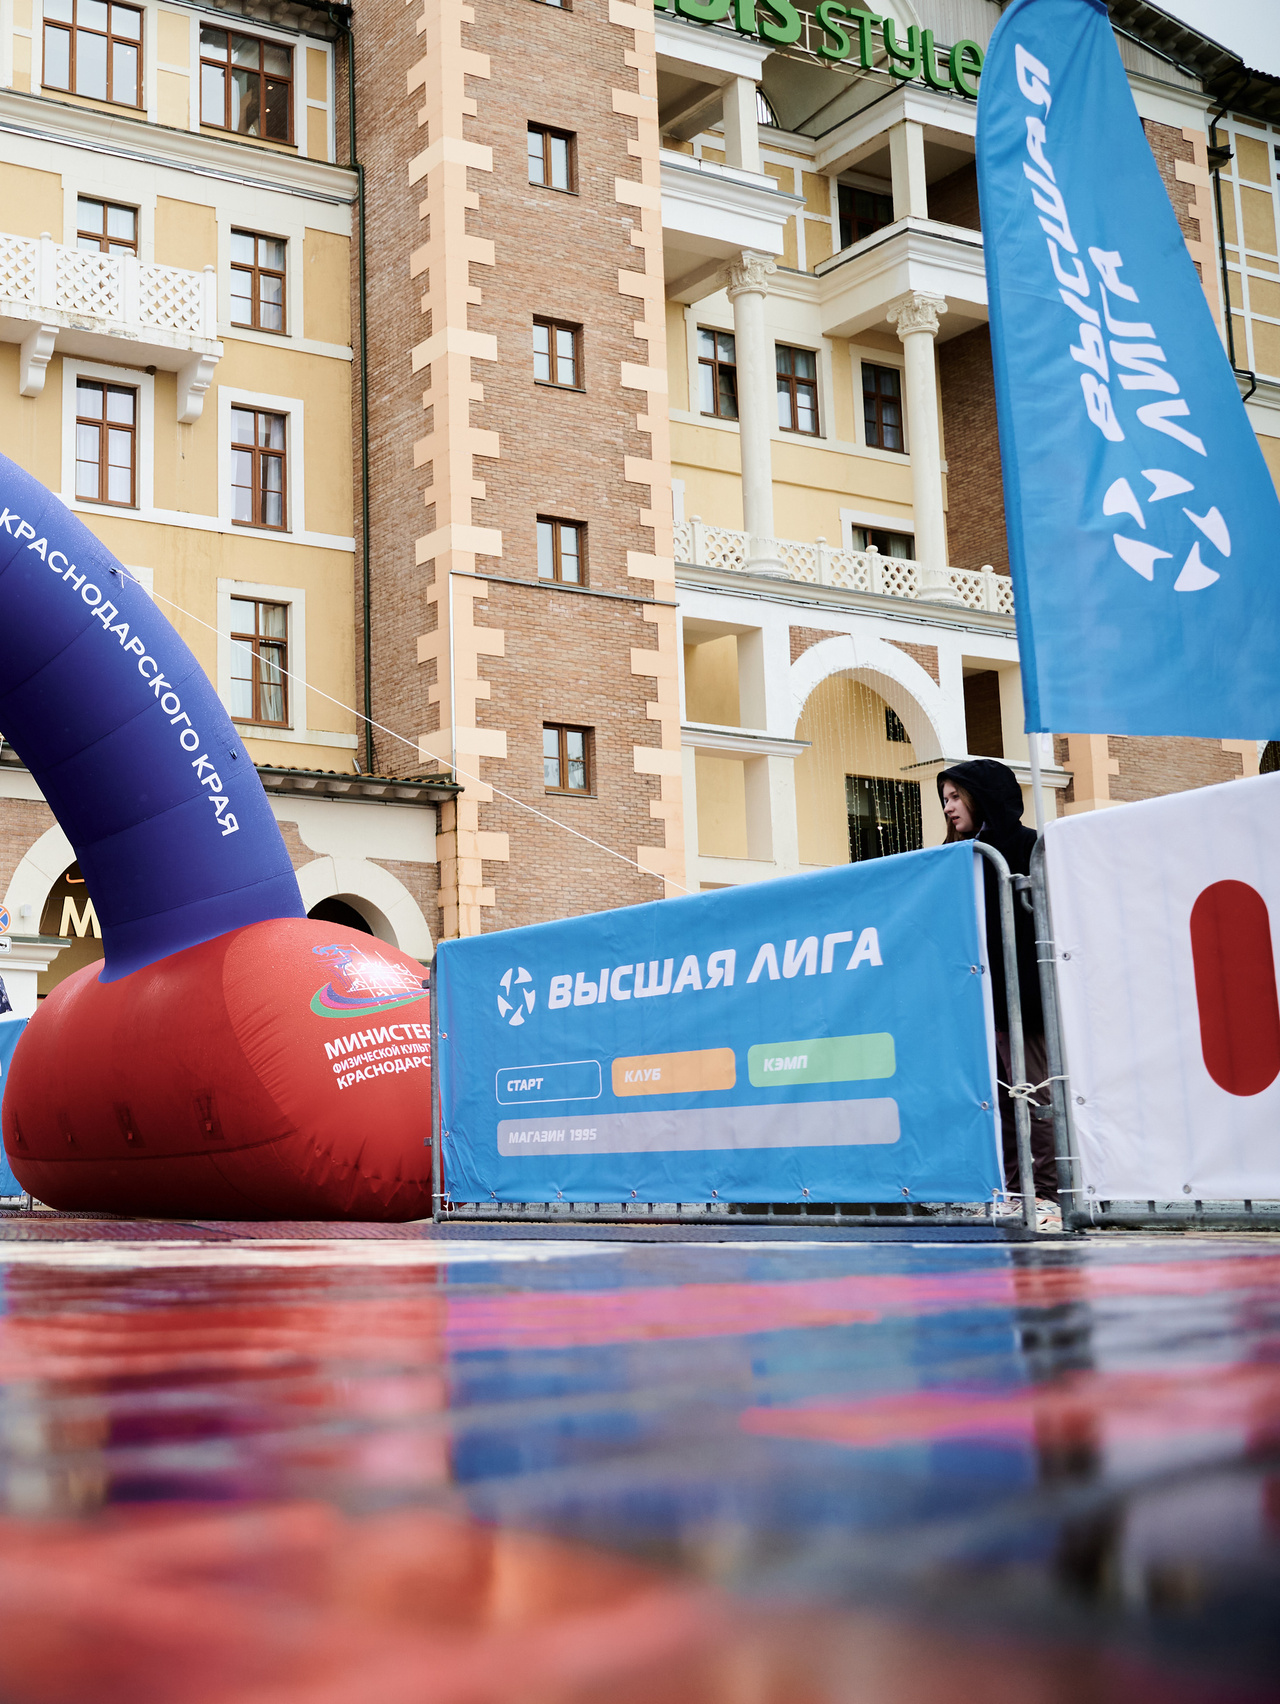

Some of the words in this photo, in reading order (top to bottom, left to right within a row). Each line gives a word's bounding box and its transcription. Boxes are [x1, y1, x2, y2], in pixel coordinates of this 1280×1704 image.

[1015, 43, 1125, 441] ВЫСШАЯ
[1088, 247, 1207, 456] ЛИГА
[191, 754, 240, 837] КРАЯ
[547, 948, 737, 1010] ВЫСШАЯ
[746, 926, 884, 984] ЛИГА
[332, 1044, 401, 1074] ФИЗИЧЕСКОЙ
[336, 1055, 431, 1090] КРАСНОДАРС
[507, 1077, 544, 1092] СТАРТ
[624, 1067, 662, 1083] КЛУБ
[763, 1054, 809, 1073] КЭМП
[508, 1129, 565, 1144] МАГАЗИН
[569, 1128, 597, 1142] 1995
